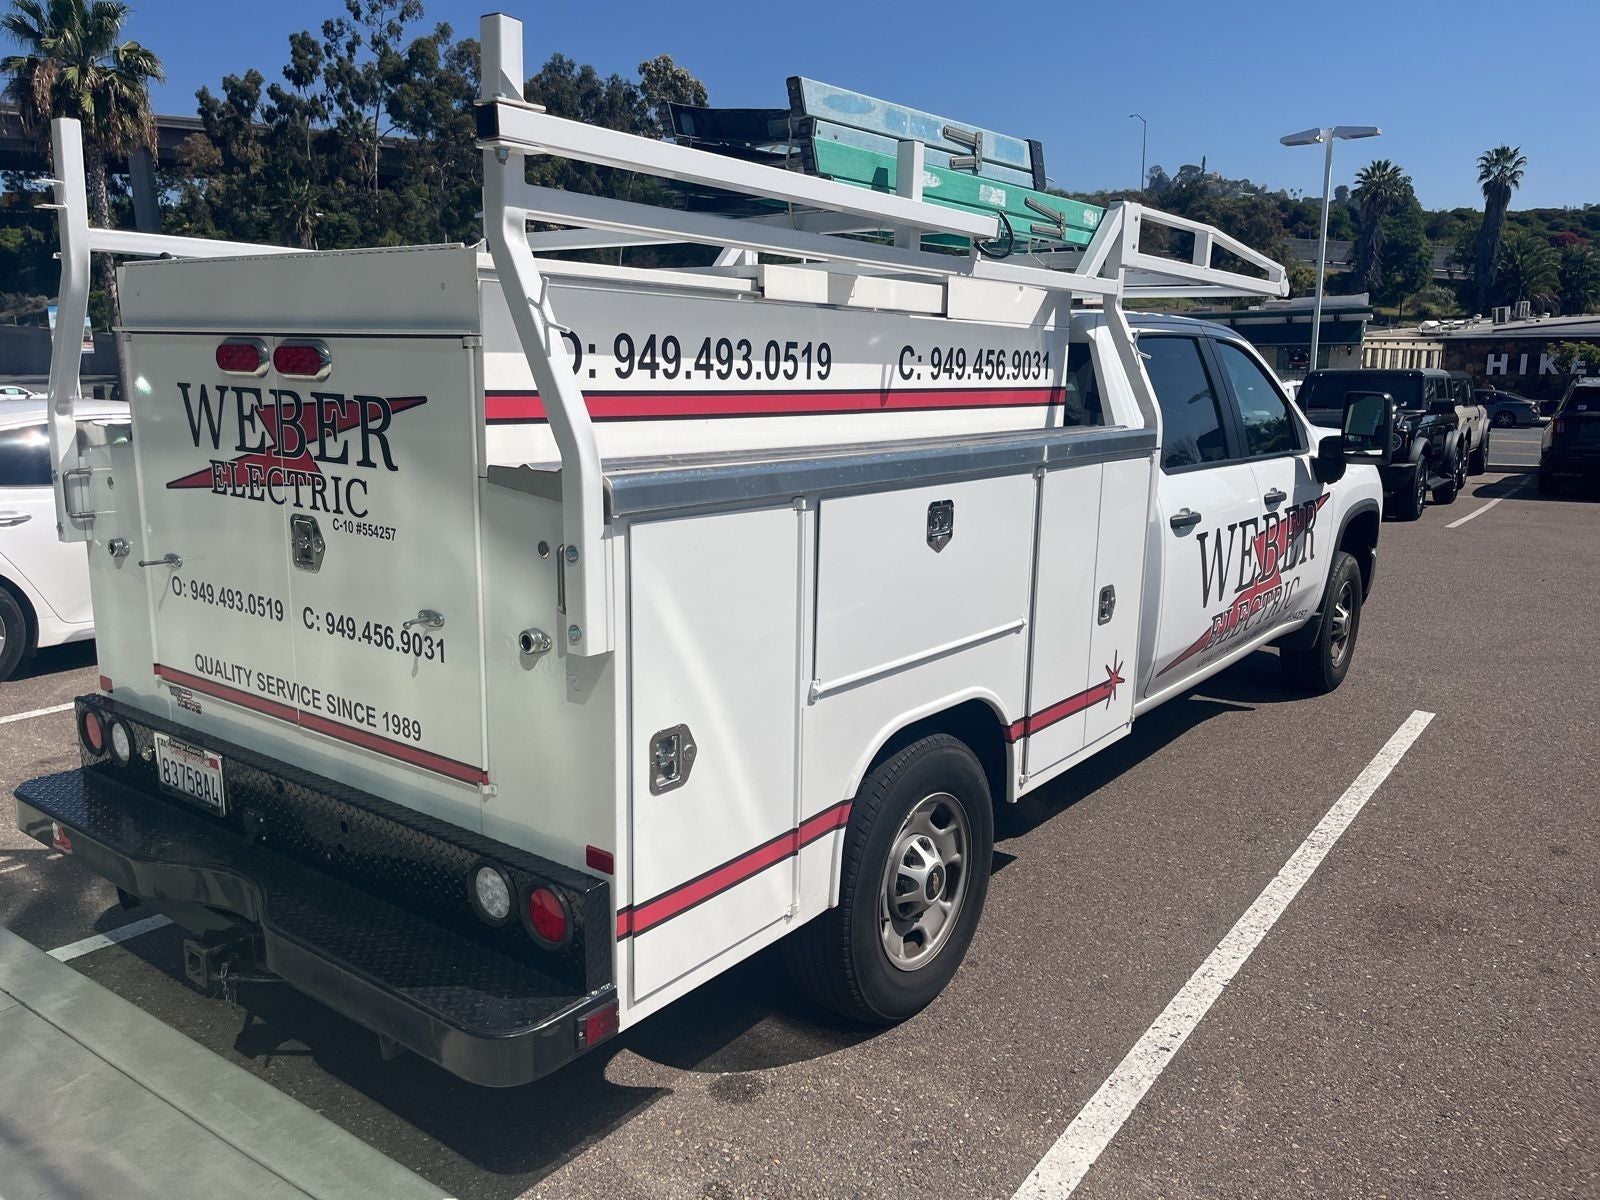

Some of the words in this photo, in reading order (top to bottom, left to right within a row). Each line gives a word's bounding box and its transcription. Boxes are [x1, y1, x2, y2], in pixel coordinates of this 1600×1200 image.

[613, 332, 832, 380] 949.493.0519
[898, 345, 922, 381] C:
[930, 346, 1050, 381] 949.456.9031
[177, 382, 398, 472] WEBER
[209, 459, 368, 518] ELECTRIC
[332, 517, 354, 535] C-10
[355, 521, 397, 541] #554257
[1196, 499, 1317, 608] WEBER
[171, 575, 187, 598] O:
[191, 579, 284, 622] 949.493.0519
[1204, 576, 1301, 651] ELECTRIC
[302, 606, 321, 632] C:
[325, 611, 446, 663] 949.456.9031
[194, 653, 253, 687] QUALITY
[257, 672, 322, 711] SERVICE
[326, 693, 377, 728] SINCE
[382, 711, 421, 742] 1989
[162, 757, 220, 804] 83758A4
